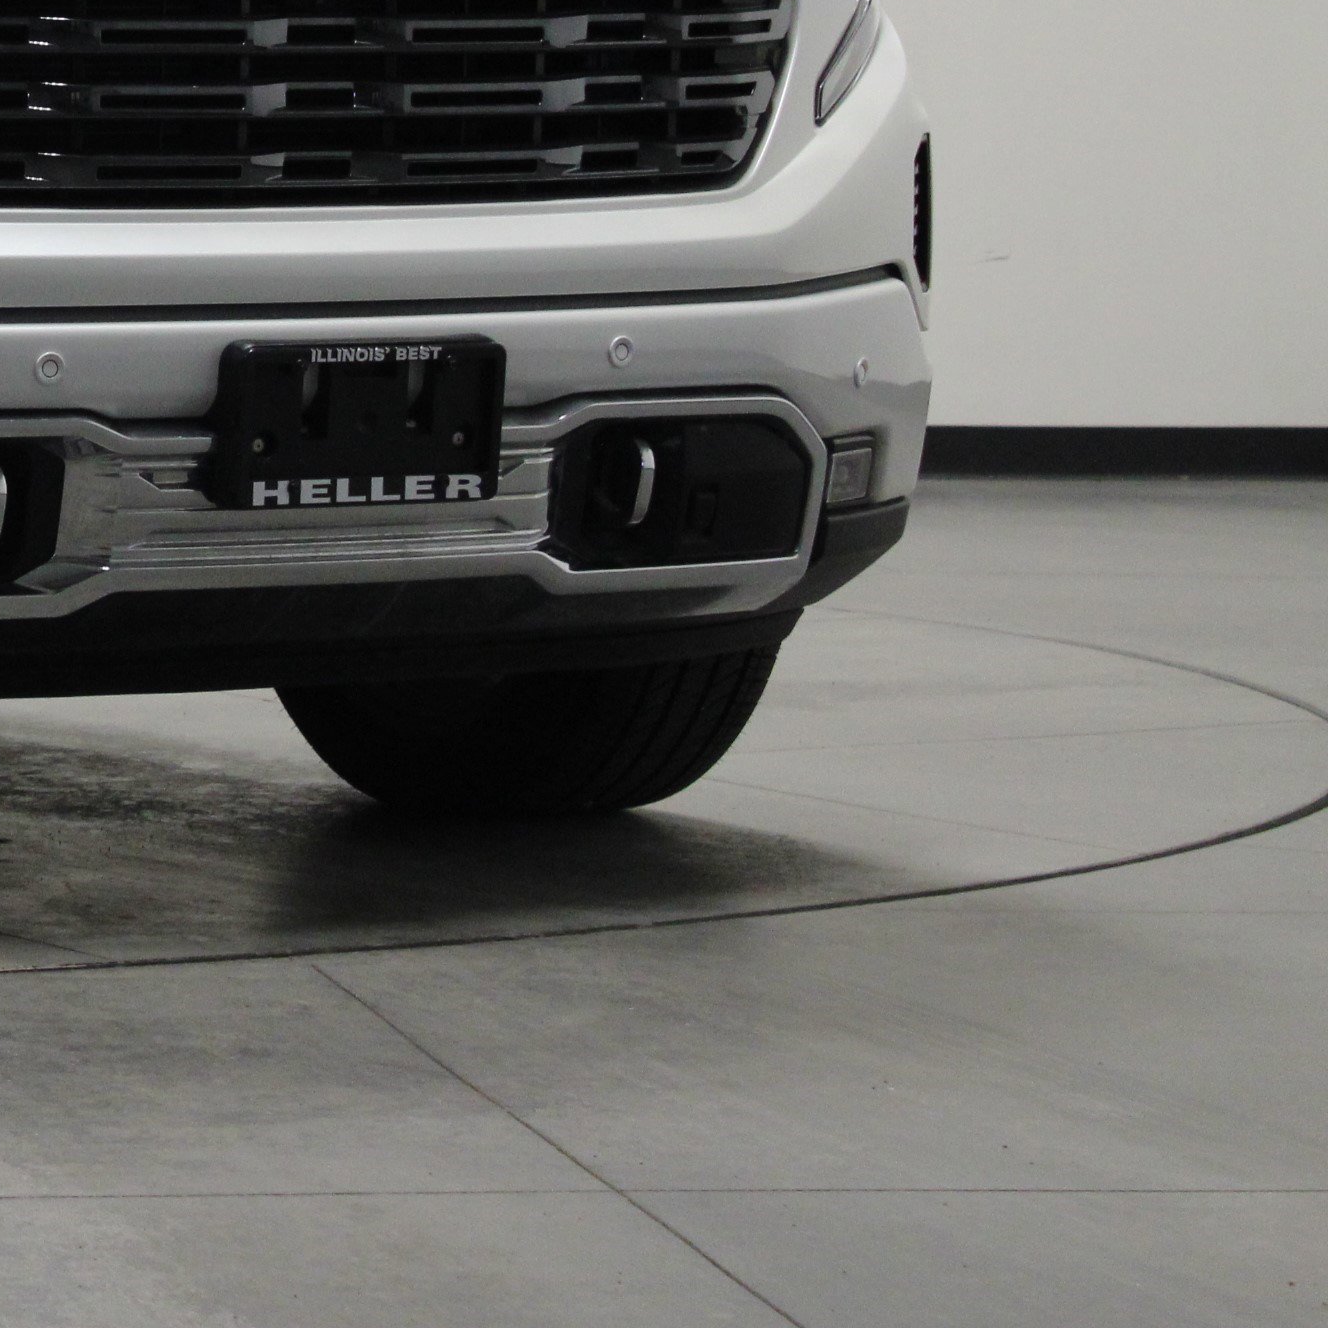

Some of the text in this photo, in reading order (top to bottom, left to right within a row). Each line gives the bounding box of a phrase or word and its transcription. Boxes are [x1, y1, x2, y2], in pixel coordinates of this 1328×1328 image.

[310, 344, 442, 364] ILLINOIS' BEST
[251, 473, 483, 508] HELLER
